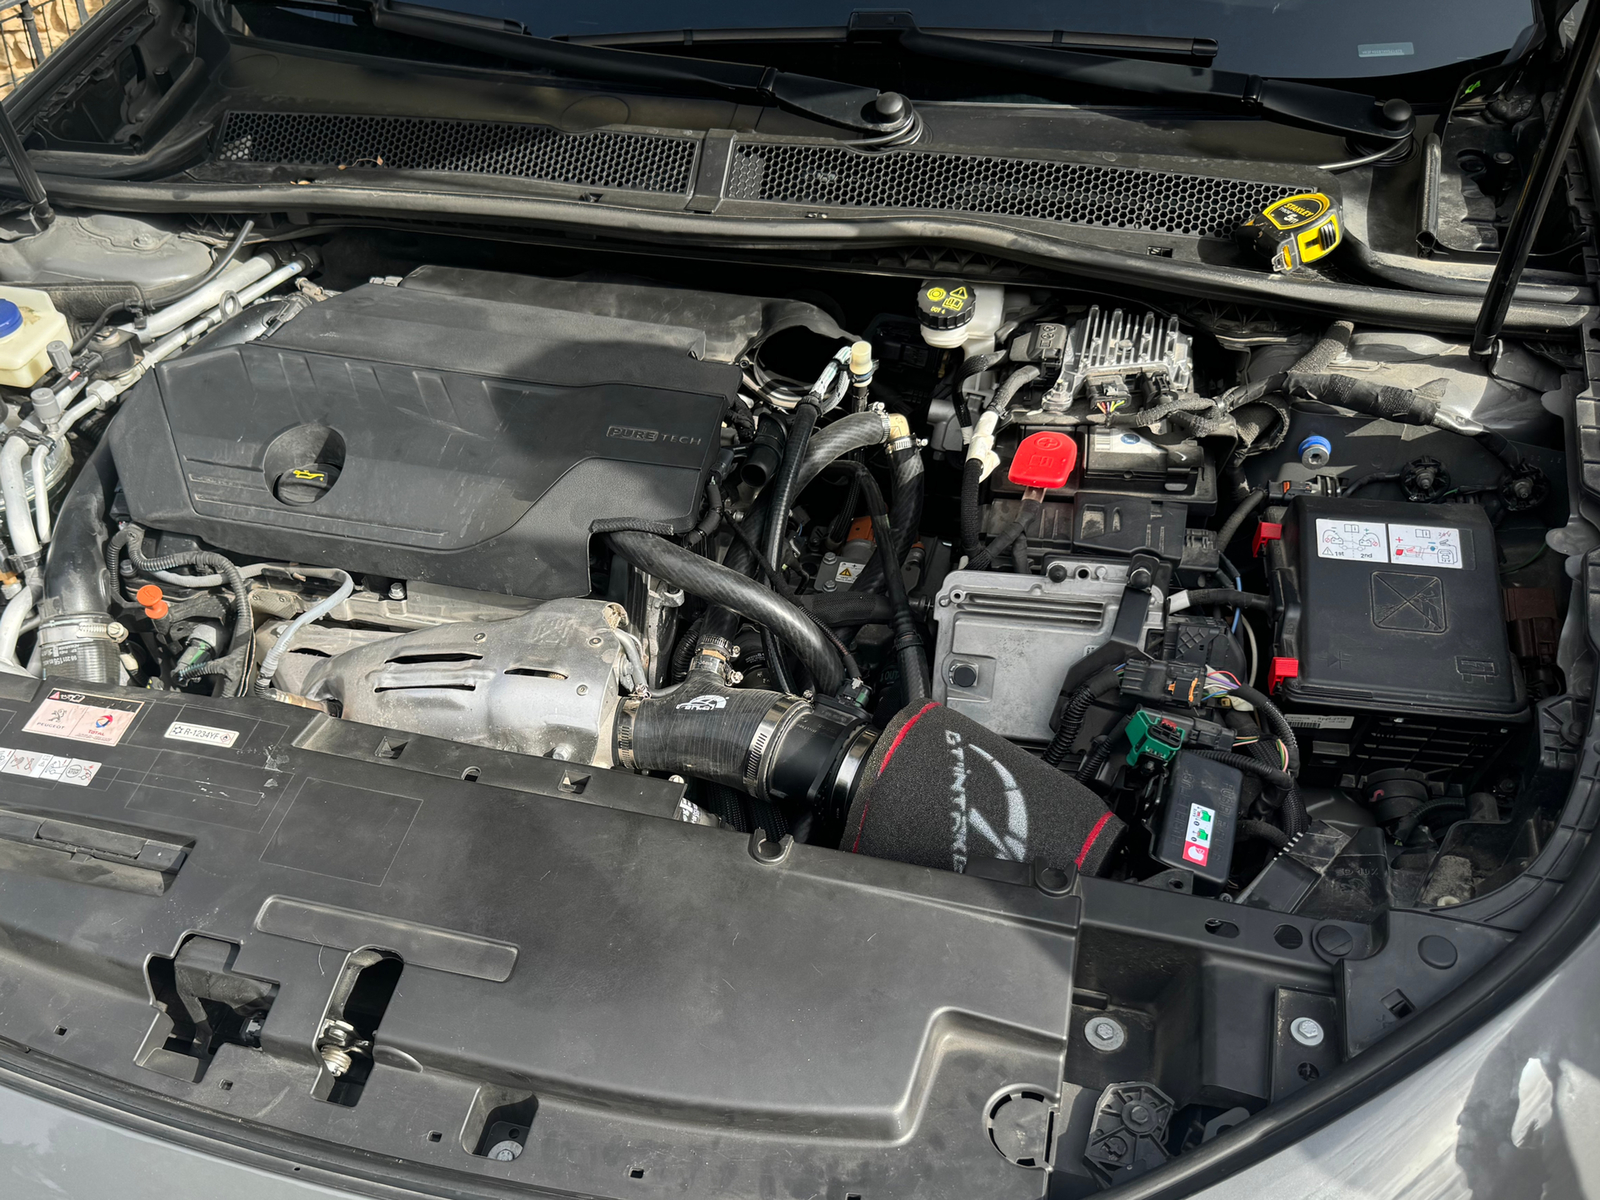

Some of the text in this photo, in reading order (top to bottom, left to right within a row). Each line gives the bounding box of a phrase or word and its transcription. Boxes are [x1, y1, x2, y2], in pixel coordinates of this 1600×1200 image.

[1284, 203, 1314, 218] STANLEY
[610, 427, 702, 446] PURE TECH
[36, 721, 65, 730] PEUGEOT
[88, 729, 105, 737] TOTAL
[183, 728, 219, 740] R-1234YF
